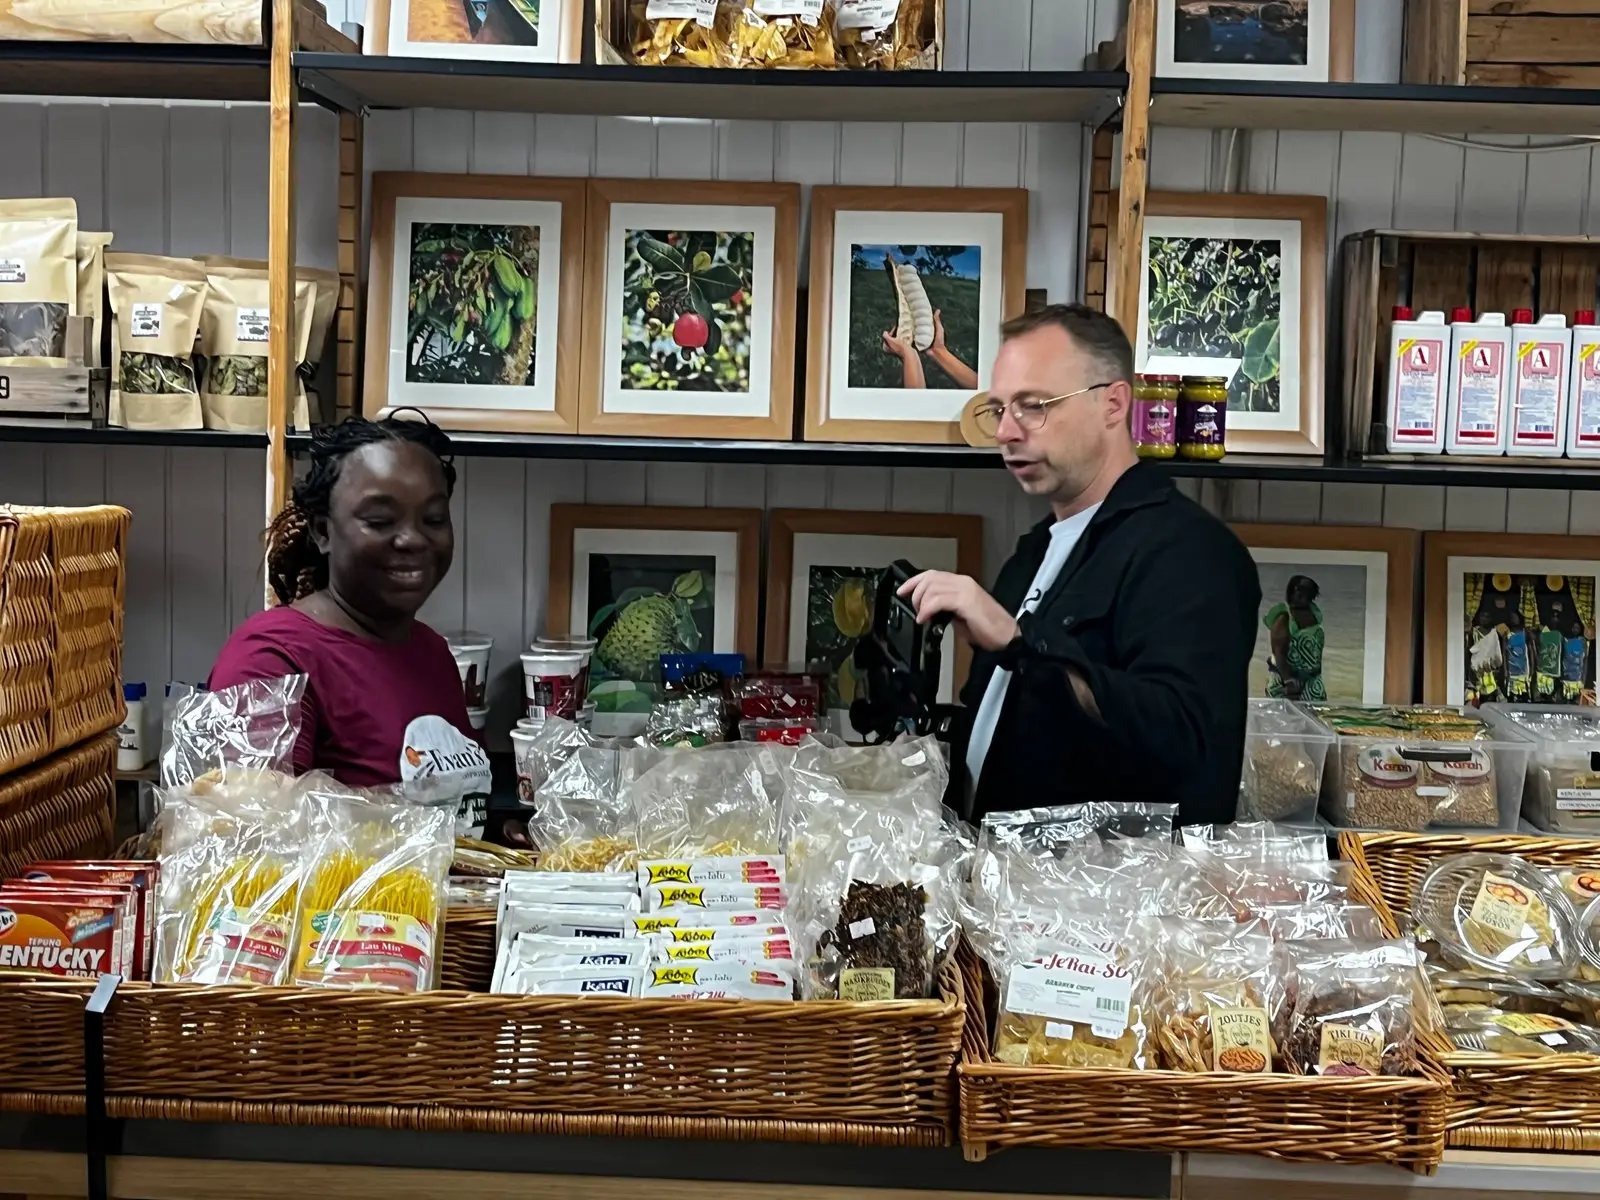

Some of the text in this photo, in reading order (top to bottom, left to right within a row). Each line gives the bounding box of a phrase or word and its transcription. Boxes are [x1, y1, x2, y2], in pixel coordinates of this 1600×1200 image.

[1413, 347, 1427, 364] A
[1475, 349, 1489, 367] A
[1533, 350, 1548, 368] A
[429, 746, 485, 772] Evan's
[361, 942, 380, 950] Lau
[0, 945, 105, 970] ENTUCKY
[586, 980, 624, 991] kara
[1217, 1013, 1262, 1027] ZOUTJES
[1327, 1029, 1351, 1041] TIKI
